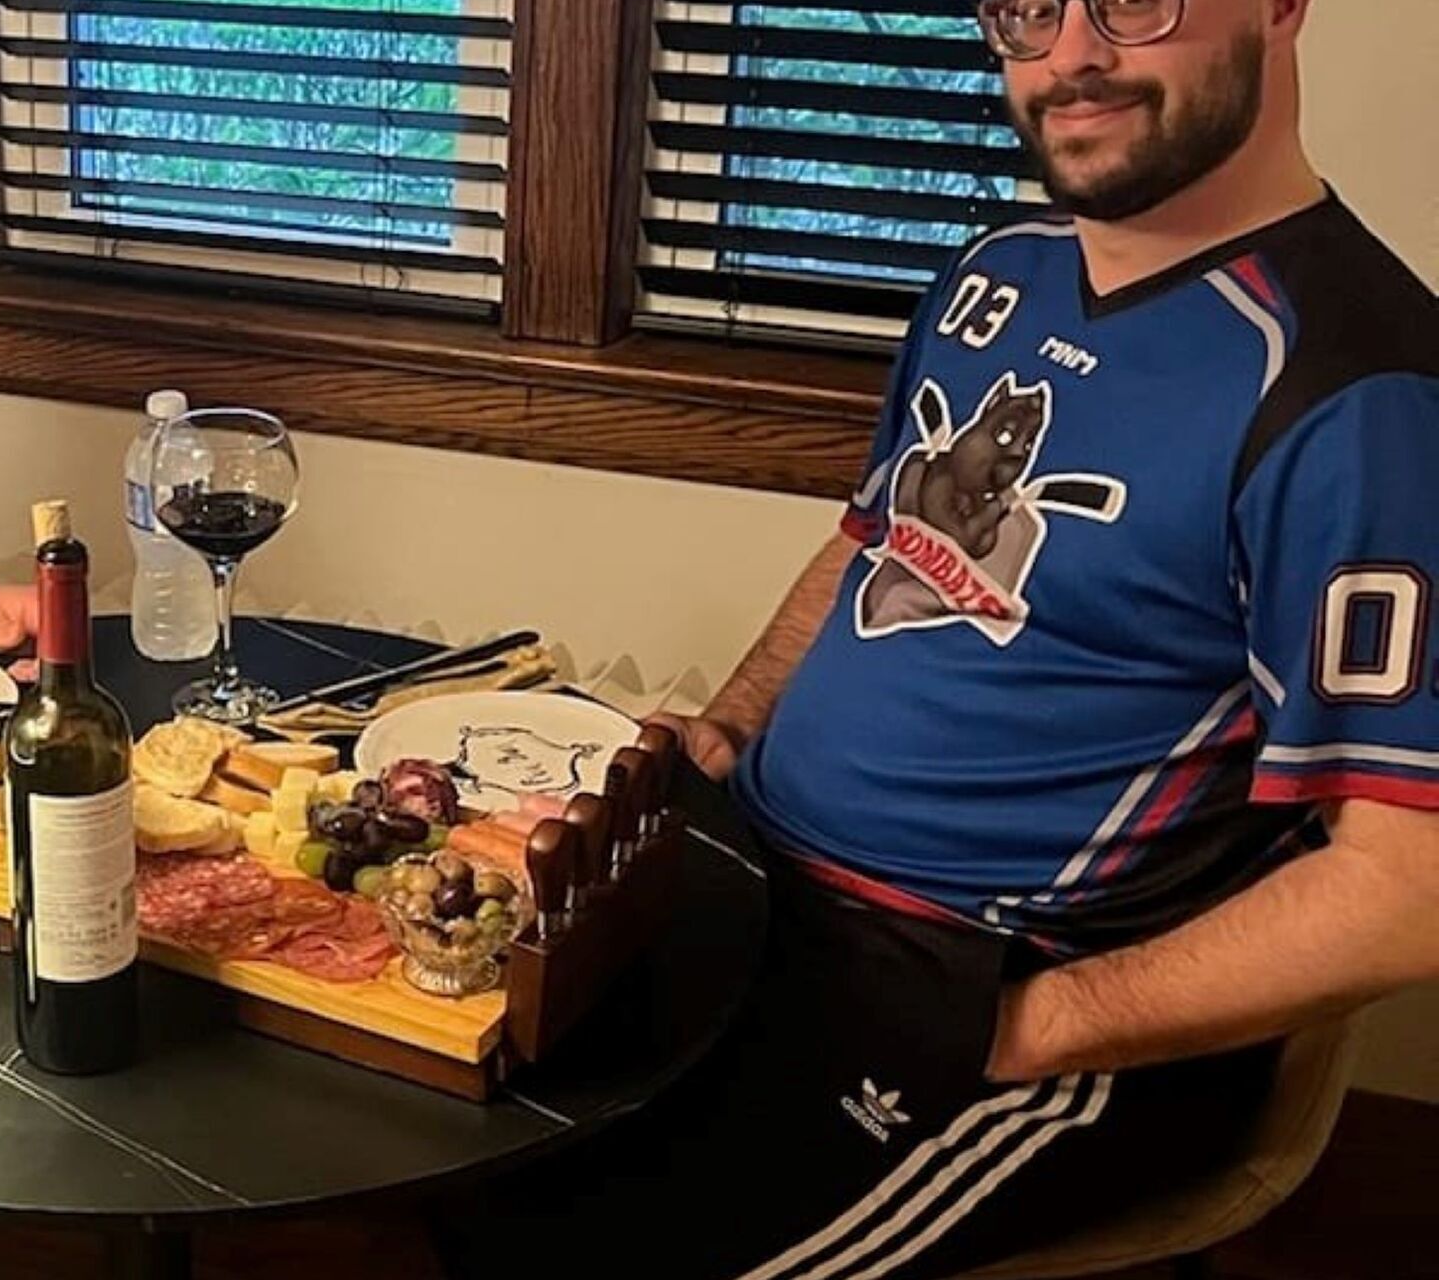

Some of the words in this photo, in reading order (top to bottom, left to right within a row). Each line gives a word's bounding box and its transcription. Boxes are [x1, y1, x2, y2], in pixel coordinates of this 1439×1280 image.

[937, 273, 1019, 349] 03
[1312, 563, 1433, 704] 0
[841, 1097, 889, 1143] adidas
